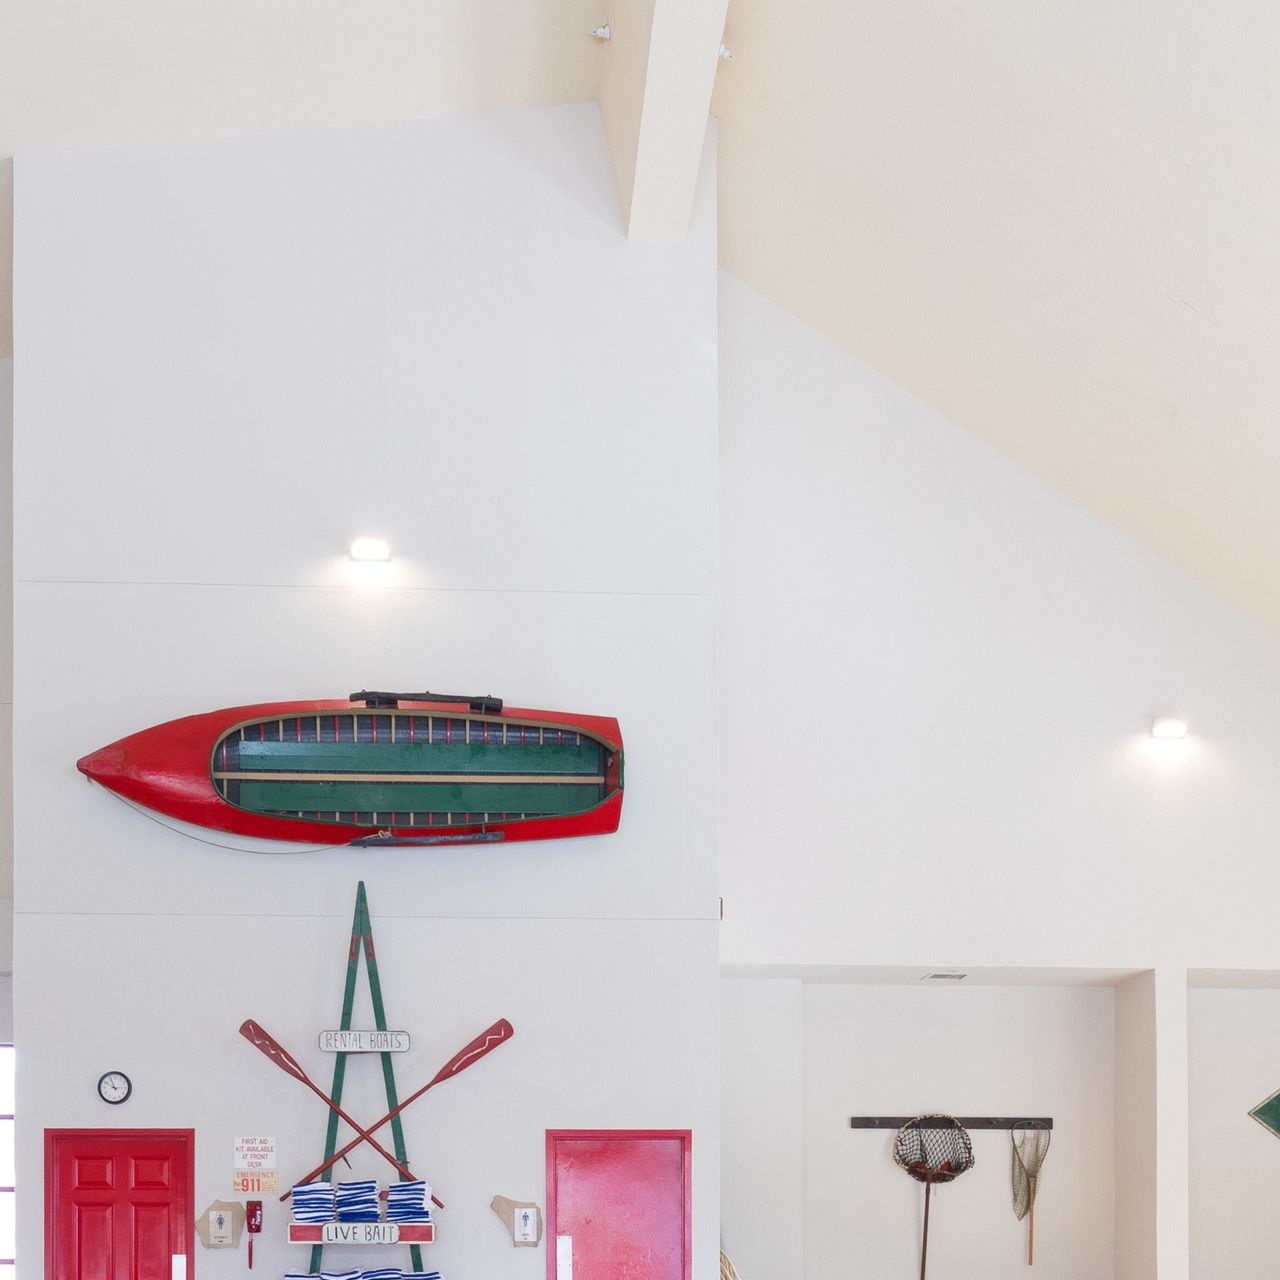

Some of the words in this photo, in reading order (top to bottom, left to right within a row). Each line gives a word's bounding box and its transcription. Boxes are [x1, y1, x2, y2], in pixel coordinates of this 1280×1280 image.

[325, 1032, 363, 1049] RENTAL
[370, 1032, 402, 1049] BOATS
[236, 1170, 274, 1178] EMERGENCY
[241, 1178, 261, 1192] 911
[326, 1226, 358, 1242] LIVE
[364, 1225, 394, 1242] BAIT
